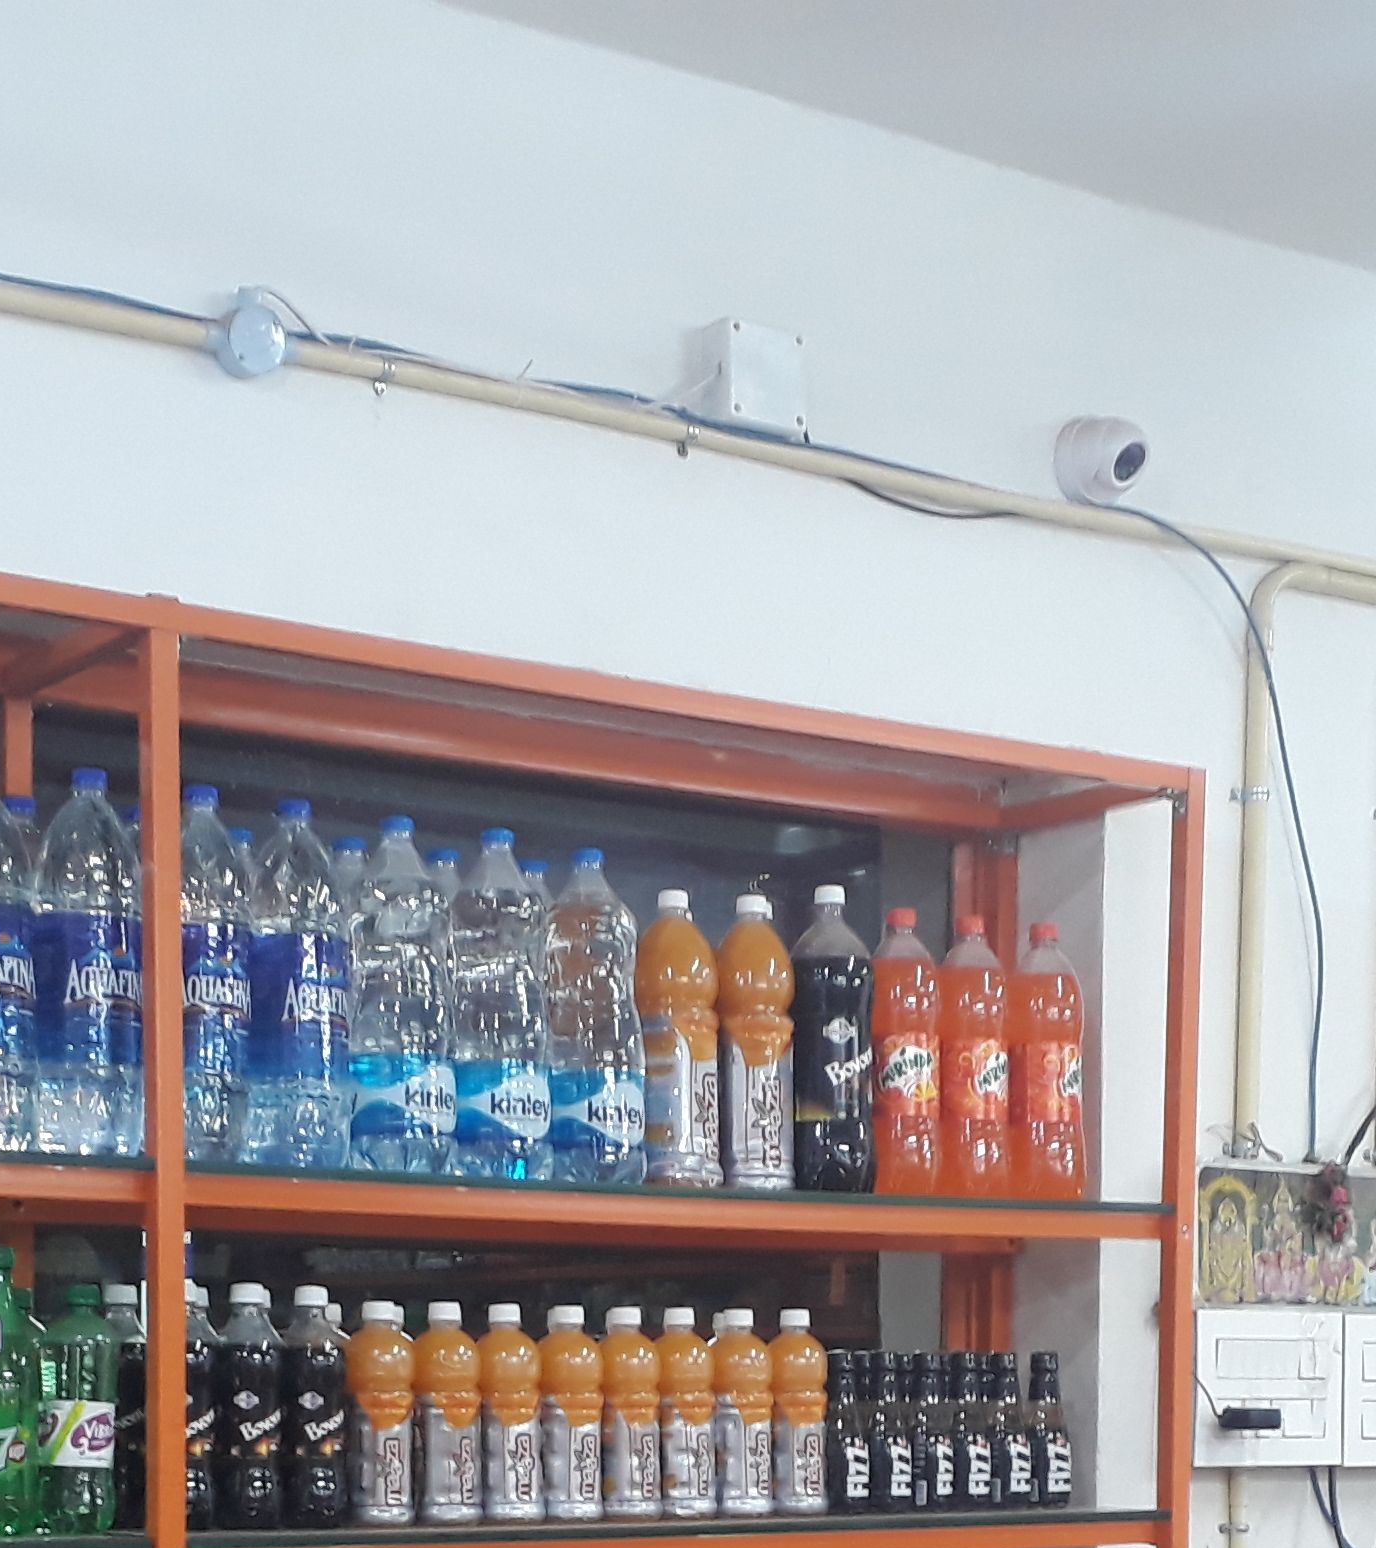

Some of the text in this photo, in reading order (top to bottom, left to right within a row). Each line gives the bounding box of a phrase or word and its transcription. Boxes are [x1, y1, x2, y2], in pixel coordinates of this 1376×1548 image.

[846, 1442, 870, 1497] FIZZ
[890, 1442, 912, 1497] FIZZ
[936, 1442, 955, 1496] FIZZ
[968, 1441, 992, 1495] FIZZ
[1010, 1441, 1032, 1493] FIZZ
[1047, 1441, 1072, 1493] FIZZ
